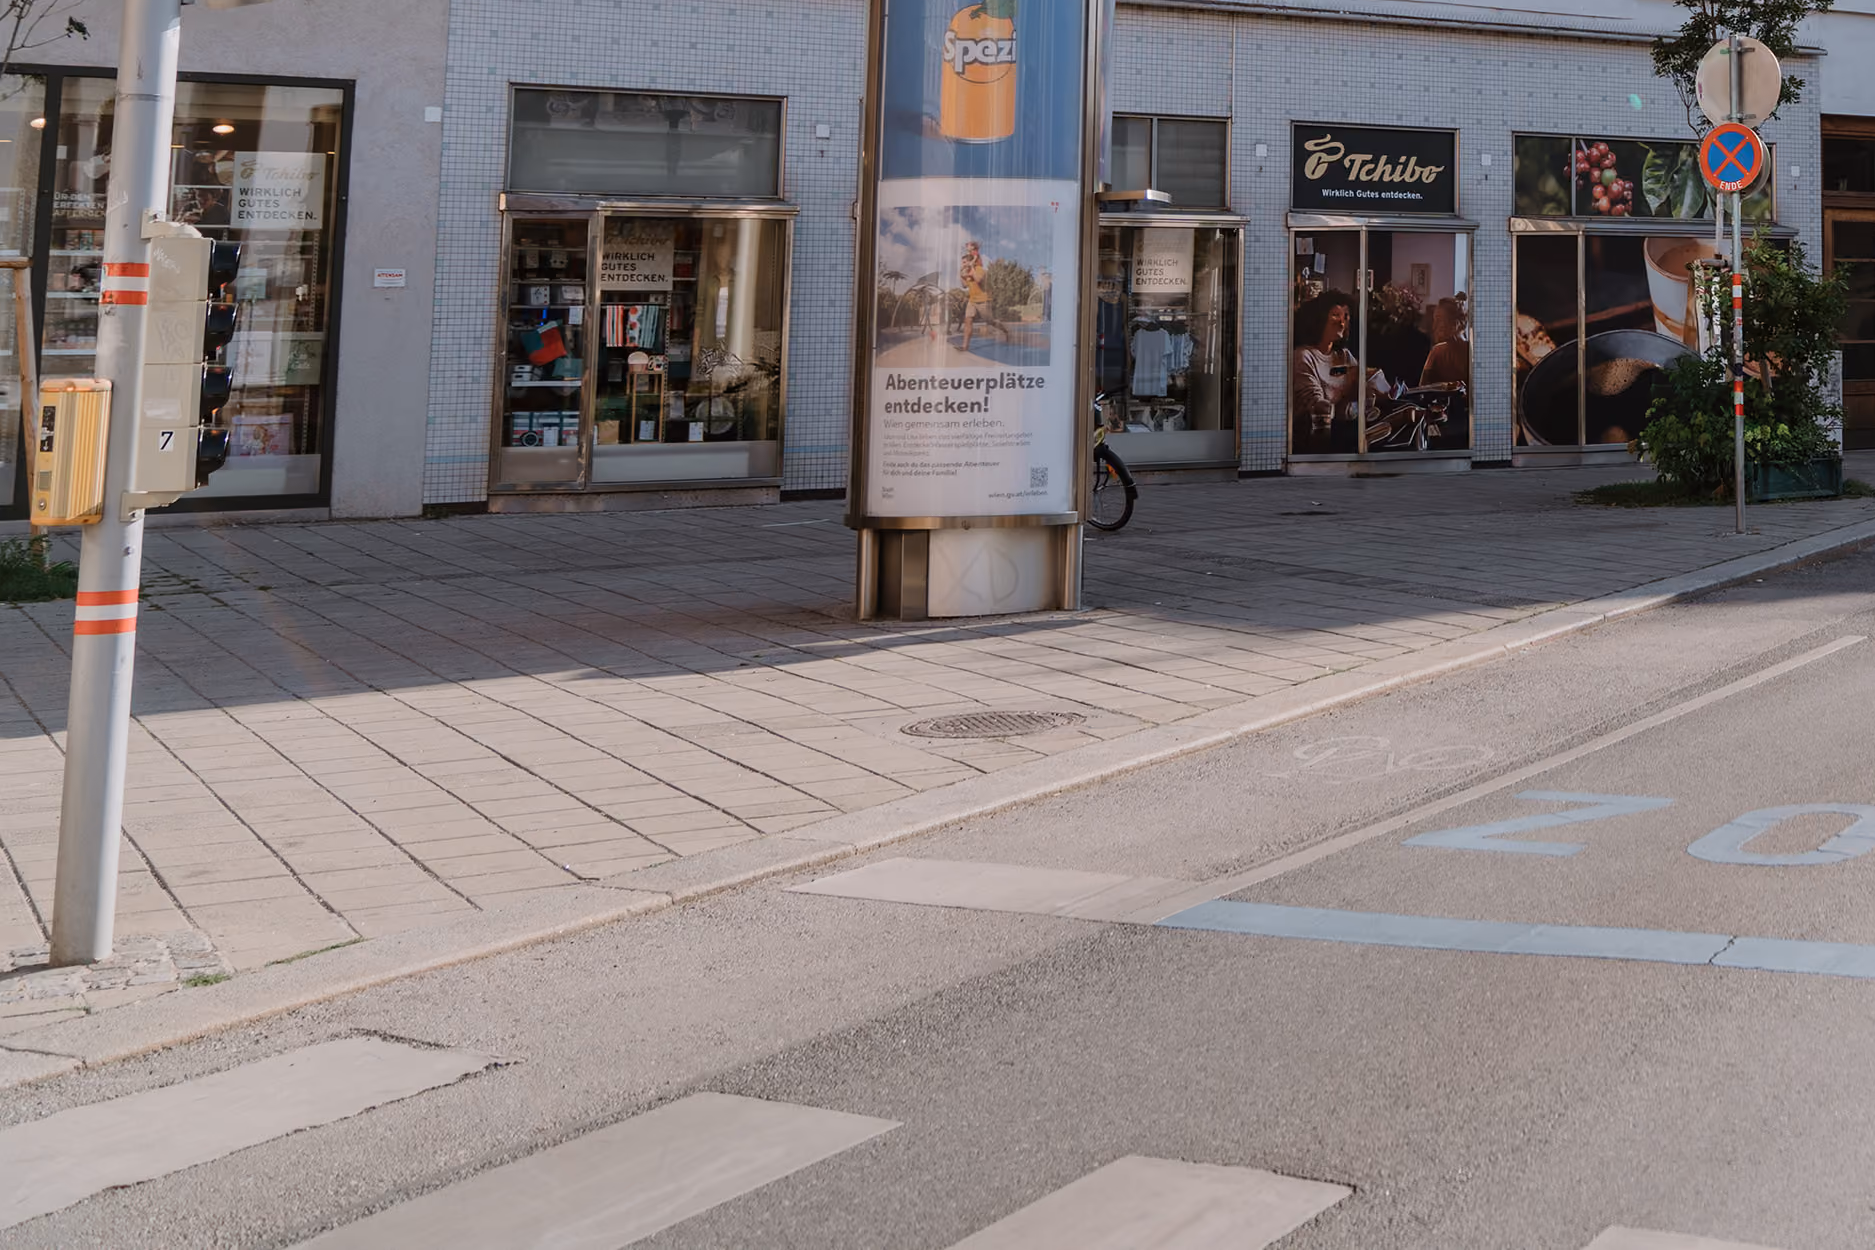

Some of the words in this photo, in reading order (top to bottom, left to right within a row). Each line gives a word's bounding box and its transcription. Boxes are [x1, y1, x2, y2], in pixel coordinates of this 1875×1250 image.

[943, 29, 1016, 75] Spezi
[1343, 153, 1445, 184] Tchibo
[1720, 180, 1744, 191] ENDE
[239, 187, 302, 197] WIRKLICH
[1321, 188, 1354, 198] Wirklich
[1356, 189, 1379, 199] Gutes
[1381, 190, 1424, 200] entdecken.
[238, 198, 280, 209] GUTES
[237, 210, 318, 221] ENTDECKEN.
[602, 252, 655, 262] WIRKLICH
[601, 262, 637, 272] GUTES
[1136, 258, 1179, 268] WIRKLICH
[601, 273, 669, 283] ENTDECKEN.
[1135, 268, 1165, 277] GUTES
[885, 372, 1045, 395] Abenteuerplätze
[884, 396, 989, 414] entdecken!
[883, 419, 903, 429] Wien
[905, 420, 960, 431] gemeinsam
[962, 418, 1005, 428] erleben.
[161, 431, 174, 451] 7
